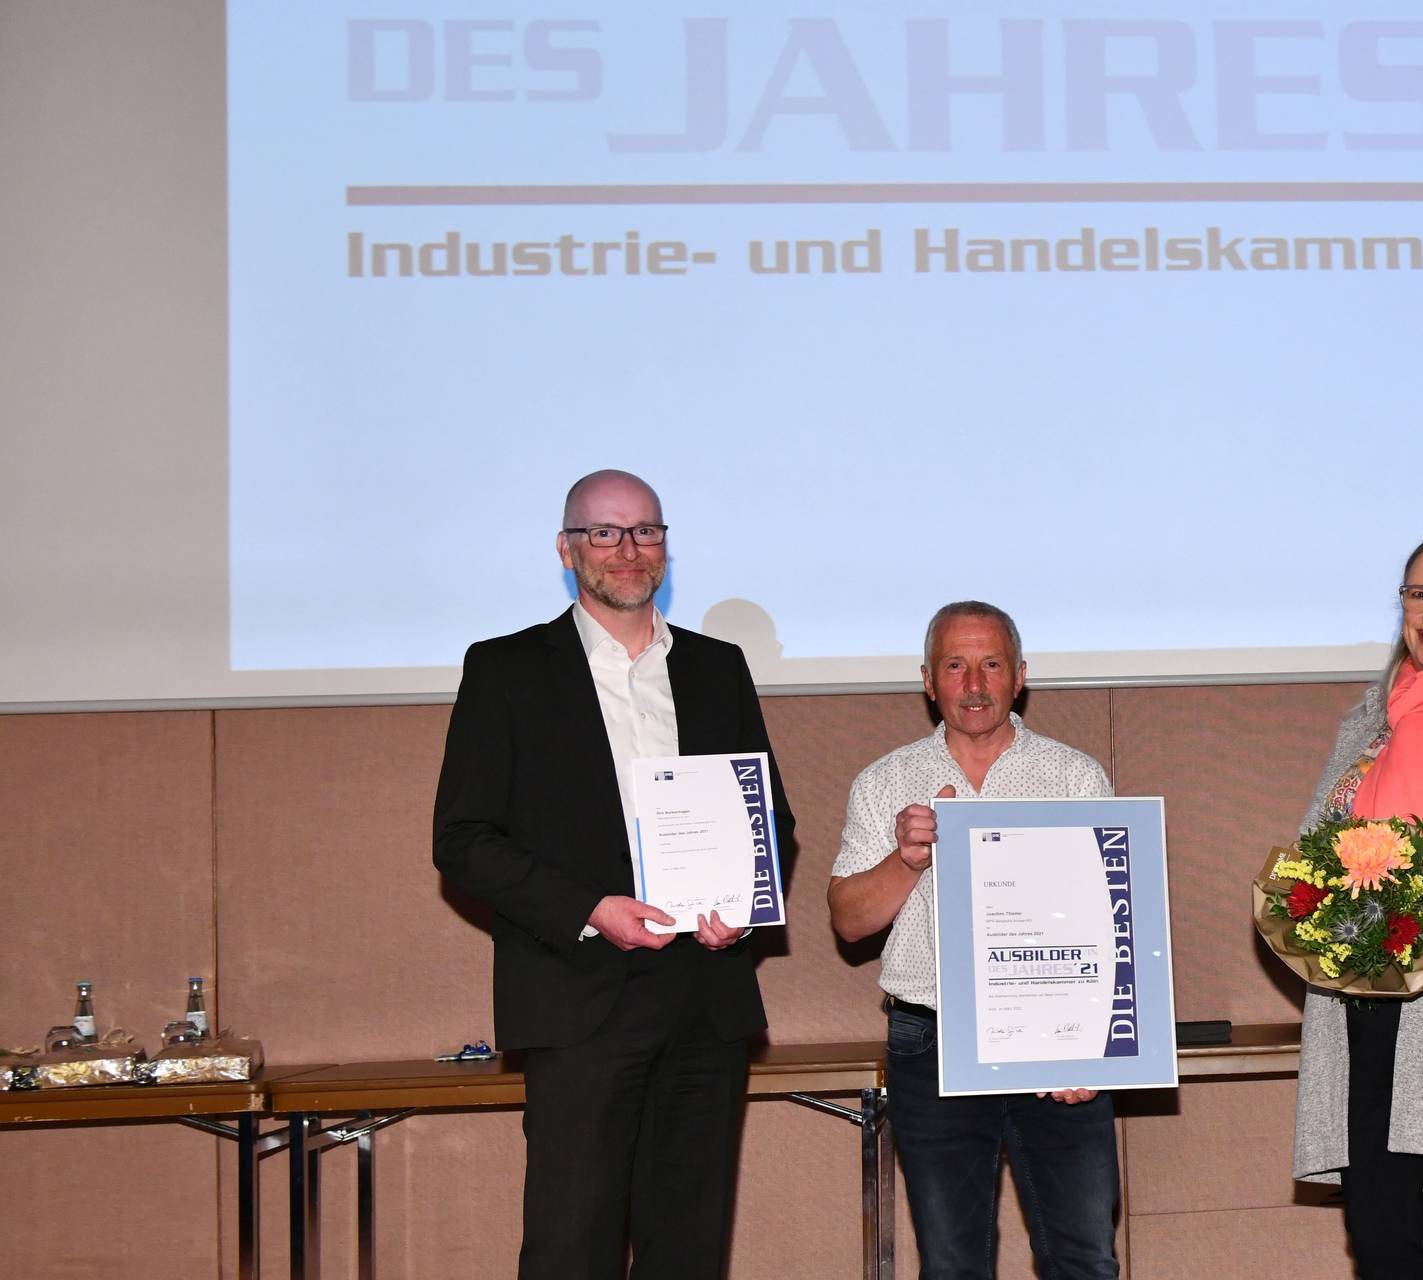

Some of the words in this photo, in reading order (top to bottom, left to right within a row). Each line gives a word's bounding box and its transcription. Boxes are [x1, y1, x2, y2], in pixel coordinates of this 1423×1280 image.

[346, 17, 602, 103] DES
[346, 230, 717, 279] Industrie-
[748, 227, 882, 275] und
[754, 869, 774, 911] DIE
[983, 880, 1017, 888] URKUNDE
[1111, 983, 1136, 1042] DIE
